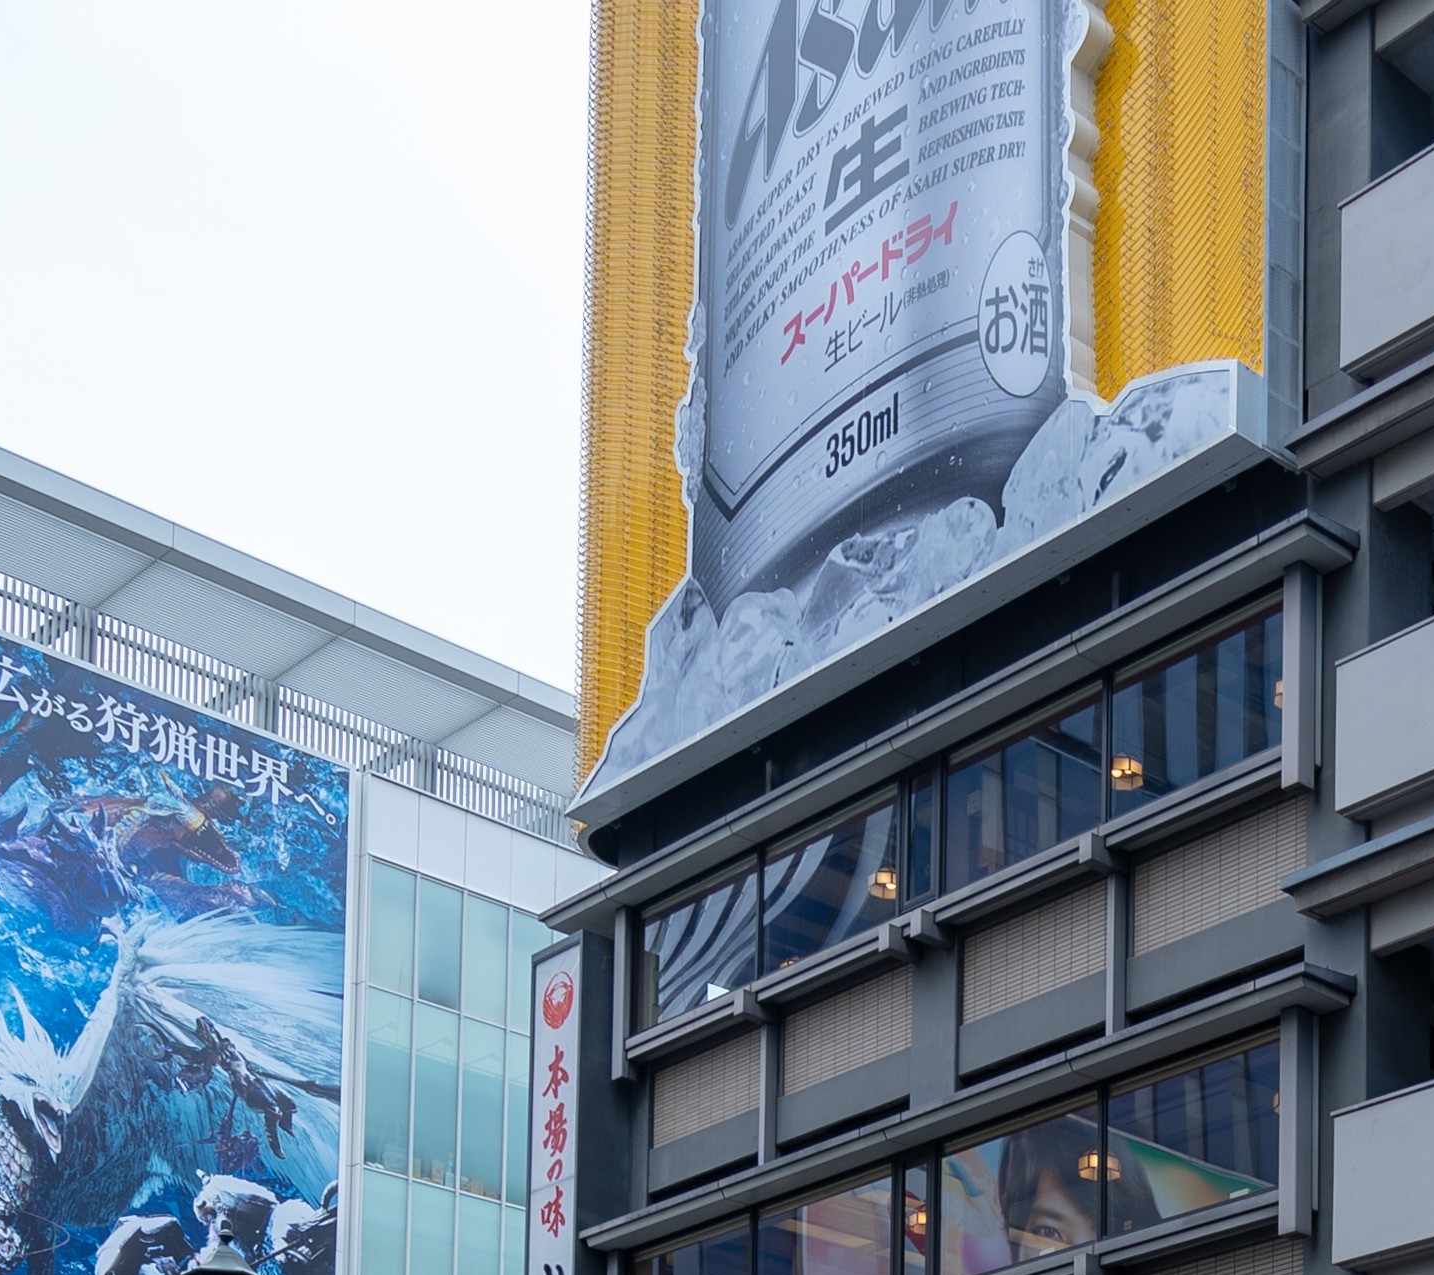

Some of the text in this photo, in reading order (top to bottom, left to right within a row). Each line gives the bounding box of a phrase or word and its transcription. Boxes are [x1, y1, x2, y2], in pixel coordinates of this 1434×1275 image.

[918, 48, 1026, 105] AND INGREDIENTS
[918, 90, 986, 136] BREWING
[756, 174, 793, 220] SUPER
[795, 144, 825, 191] DRY
[843, 73, 904, 138] BREWED
[908, 42, 953, 87] USING
[956, 18, 1025, 57] CAREFULLY
[918, 109, 1026, 165] REFRESHING TASTE
[776, 172, 817, 227] YEAST
[823, 104, 910, 237] 生
[779, 210, 875, 305] SMOOTHNESS
[878, 189, 903, 221] OF
[903, 162, 949, 205] ASAHI
[951, 147, 996, 180] SUPER
[997, 140, 1027, 162] DRY!
[781, 201, 958, 365] スーパードライ
[984, 283, 1050, 358] お酒
[825, 392, 900, 480] 350ml
